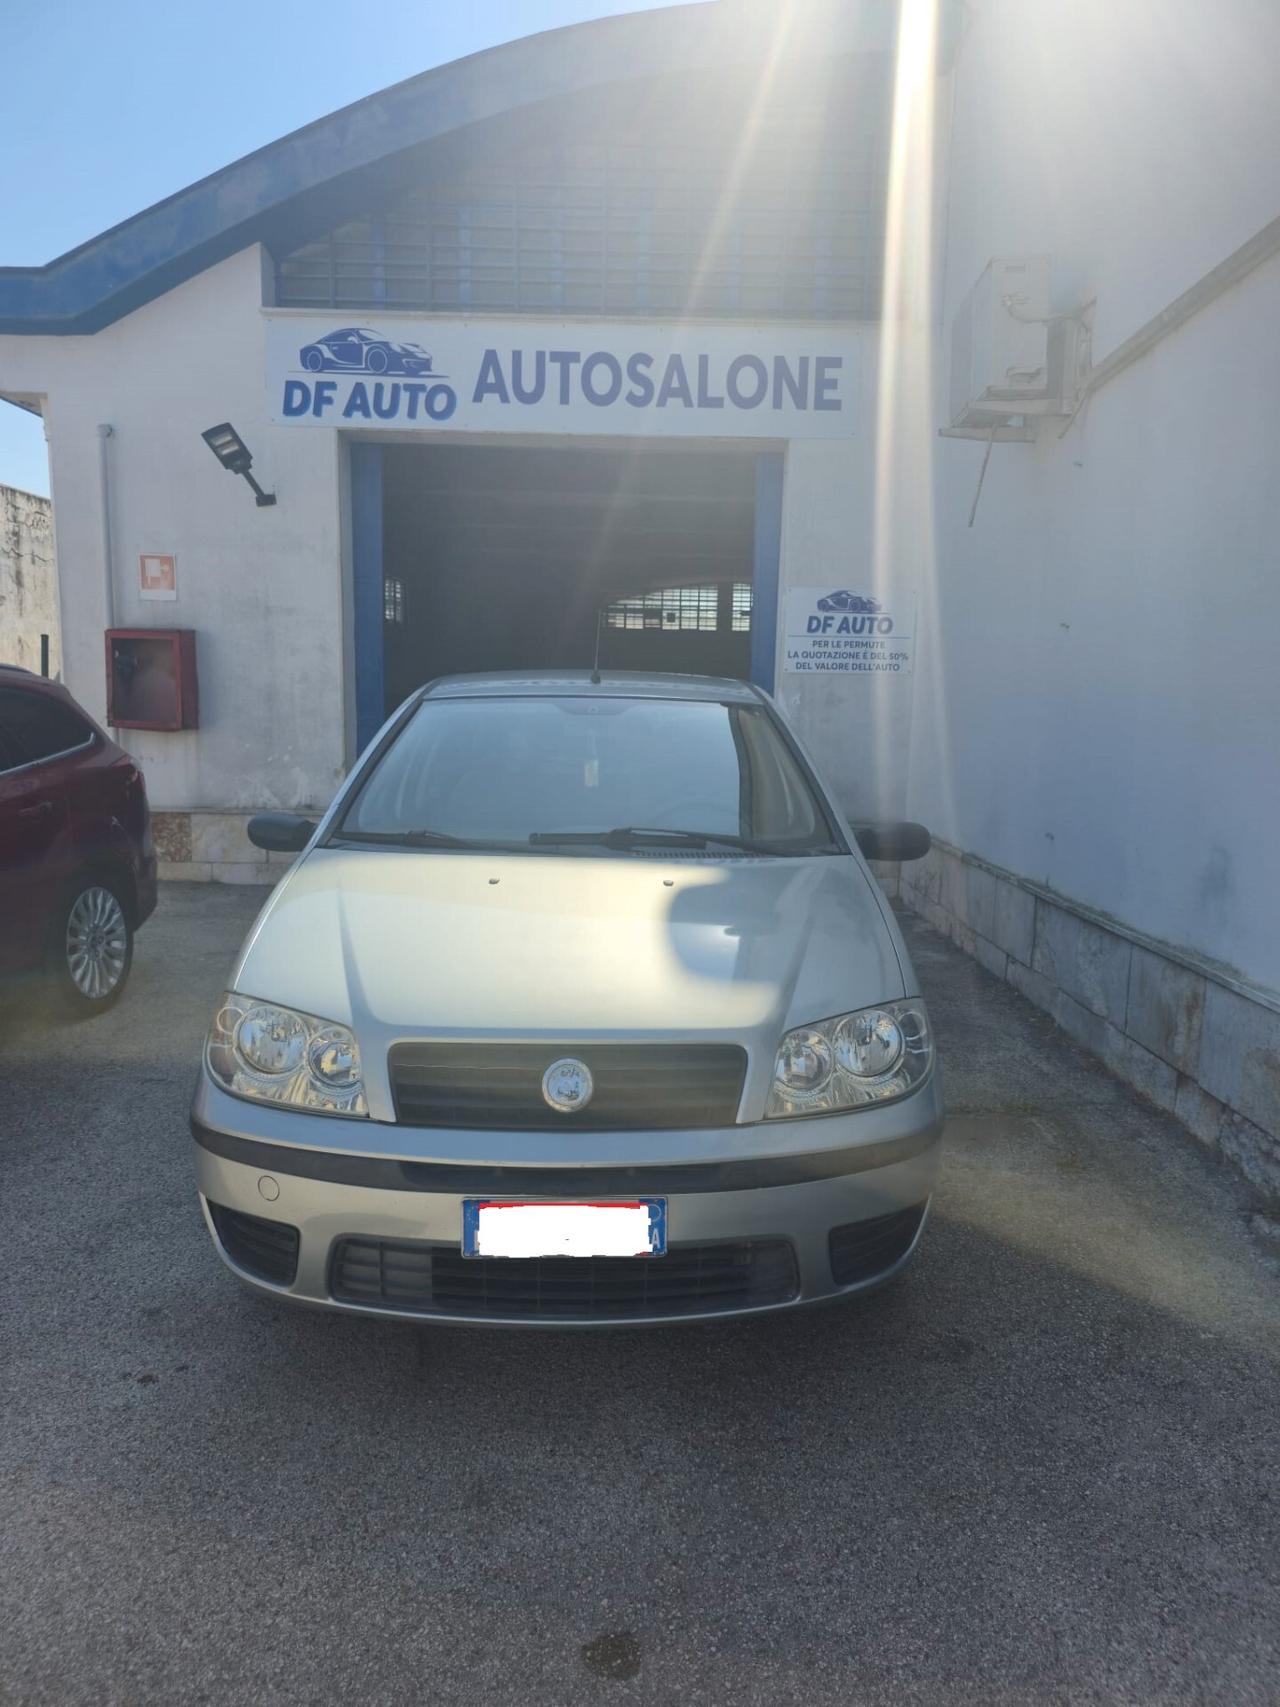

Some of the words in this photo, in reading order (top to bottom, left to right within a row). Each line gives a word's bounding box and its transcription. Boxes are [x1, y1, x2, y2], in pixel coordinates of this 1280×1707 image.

[472, 348, 843, 411] AUTOSALONE
[282, 379, 338, 418] DF
[342, 382, 457, 421] AUTO
[806, 615, 835, 634] DF
[836, 616, 894, 635] AUTO
[812, 640, 829, 648] PER
[831, 640, 841, 648] LE
[844, 640, 886, 649] PERMUTE
[787, 650, 799, 659] LA
[801, 651, 861, 660] QUOTAZIONE
[870, 651, 887, 660] DEL
[795, 662, 812, 670] DEL
[814, 662, 849, 671] VALORE
[851, 662, 900, 672] DELL'AUTO
